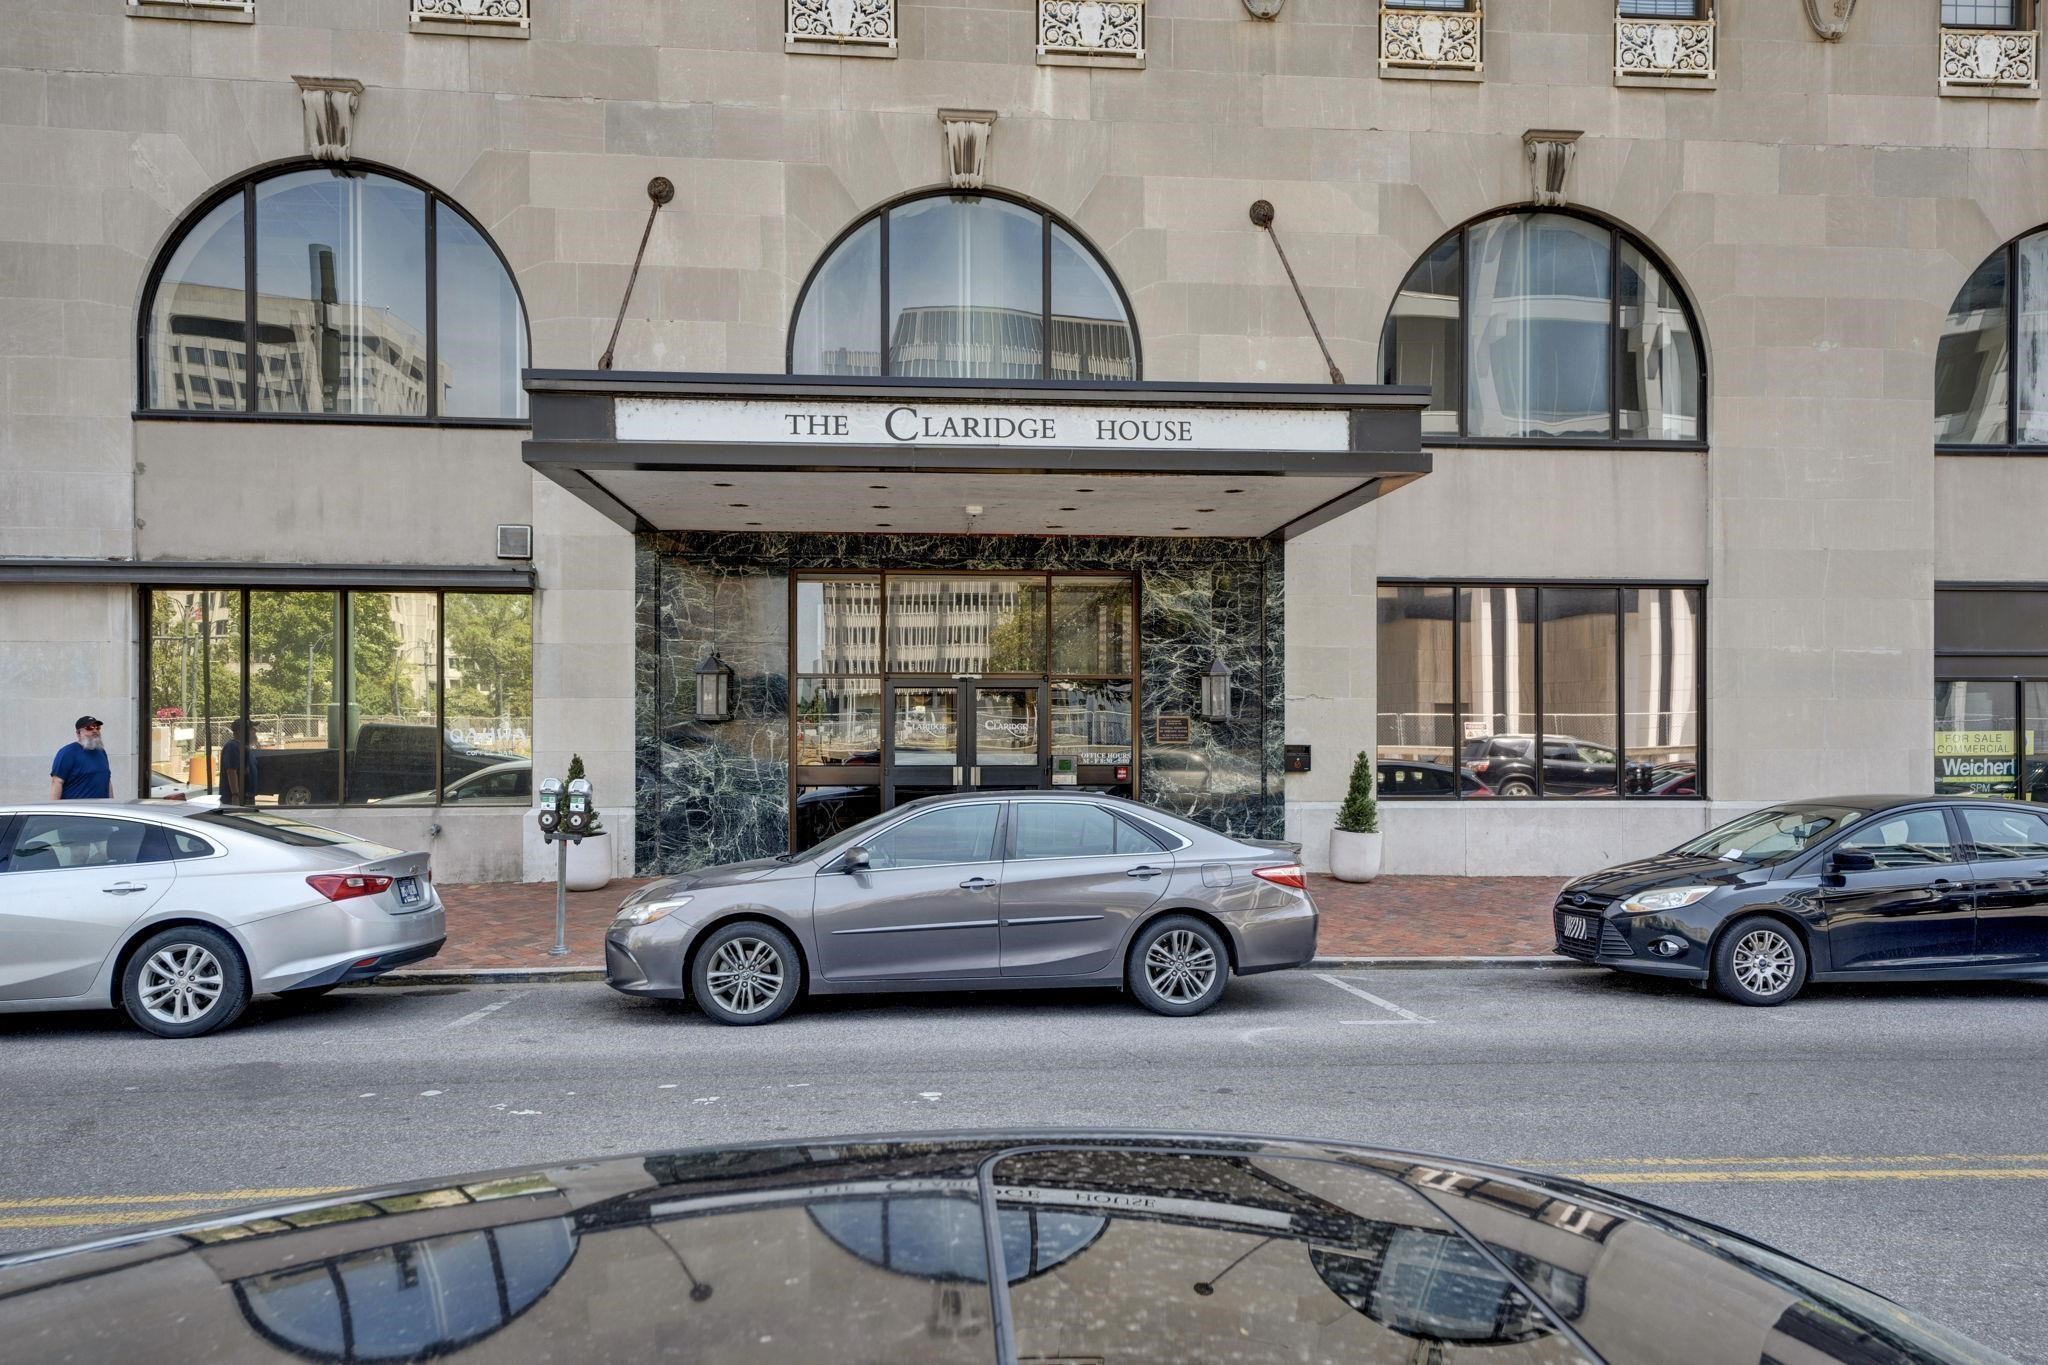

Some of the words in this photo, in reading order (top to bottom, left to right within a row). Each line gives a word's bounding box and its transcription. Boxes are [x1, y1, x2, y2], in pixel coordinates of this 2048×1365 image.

[785, 414, 849, 436] THE
[885, 406, 1056, 442] CLARIDGE
[1096, 419, 1192, 441] HOUSE
[1945, 734, 1969, 743] FOR
[1974, 733, 2003, 743] SALE
[1937, 744, 2010, 754] COMMERCIAL
[1942, 758, 2015, 776] Weichert
[1969, 783, 1991, 793] SPM
